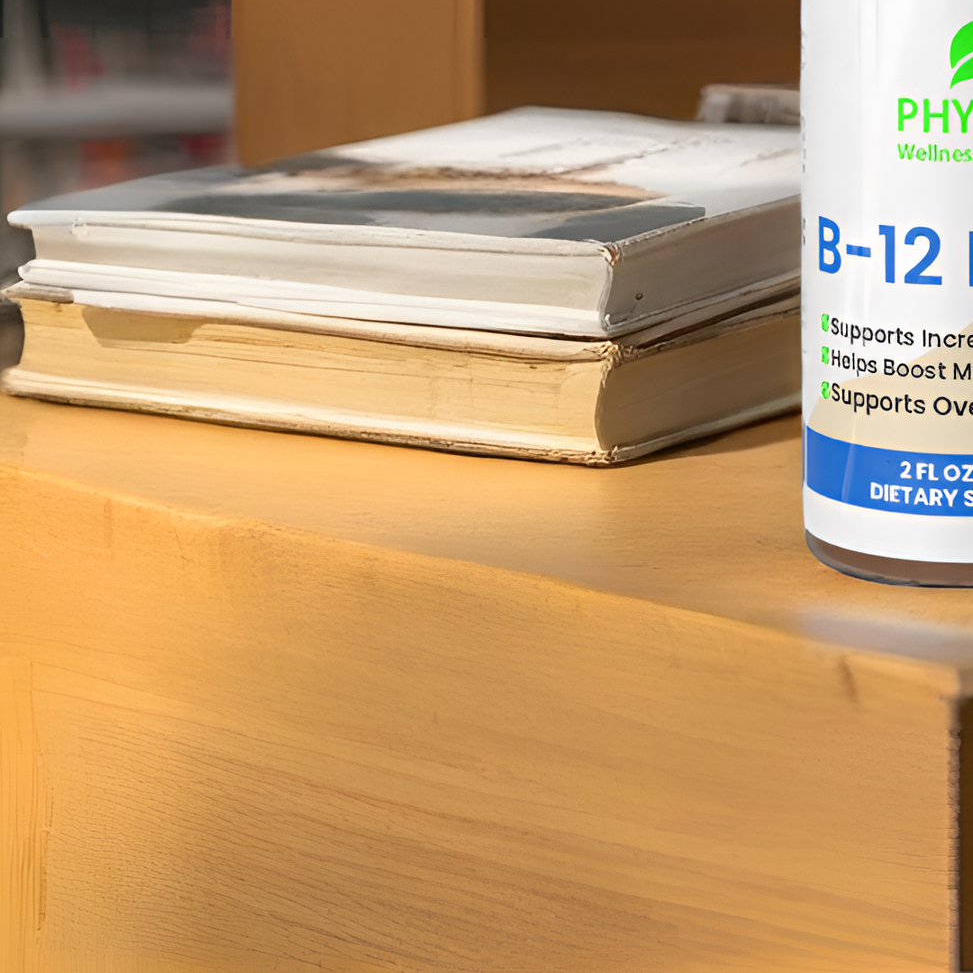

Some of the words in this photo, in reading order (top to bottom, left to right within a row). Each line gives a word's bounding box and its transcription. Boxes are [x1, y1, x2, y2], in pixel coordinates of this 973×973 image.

[818, 215, 943, 286] B-12
[830, 317, 915, 346] Supports
[831, 349, 878, 377] Helps
[883, 358, 947, 380] Boost
[831, 382, 926, 416] Supports
[869, 481, 957, 507] DIETARY
